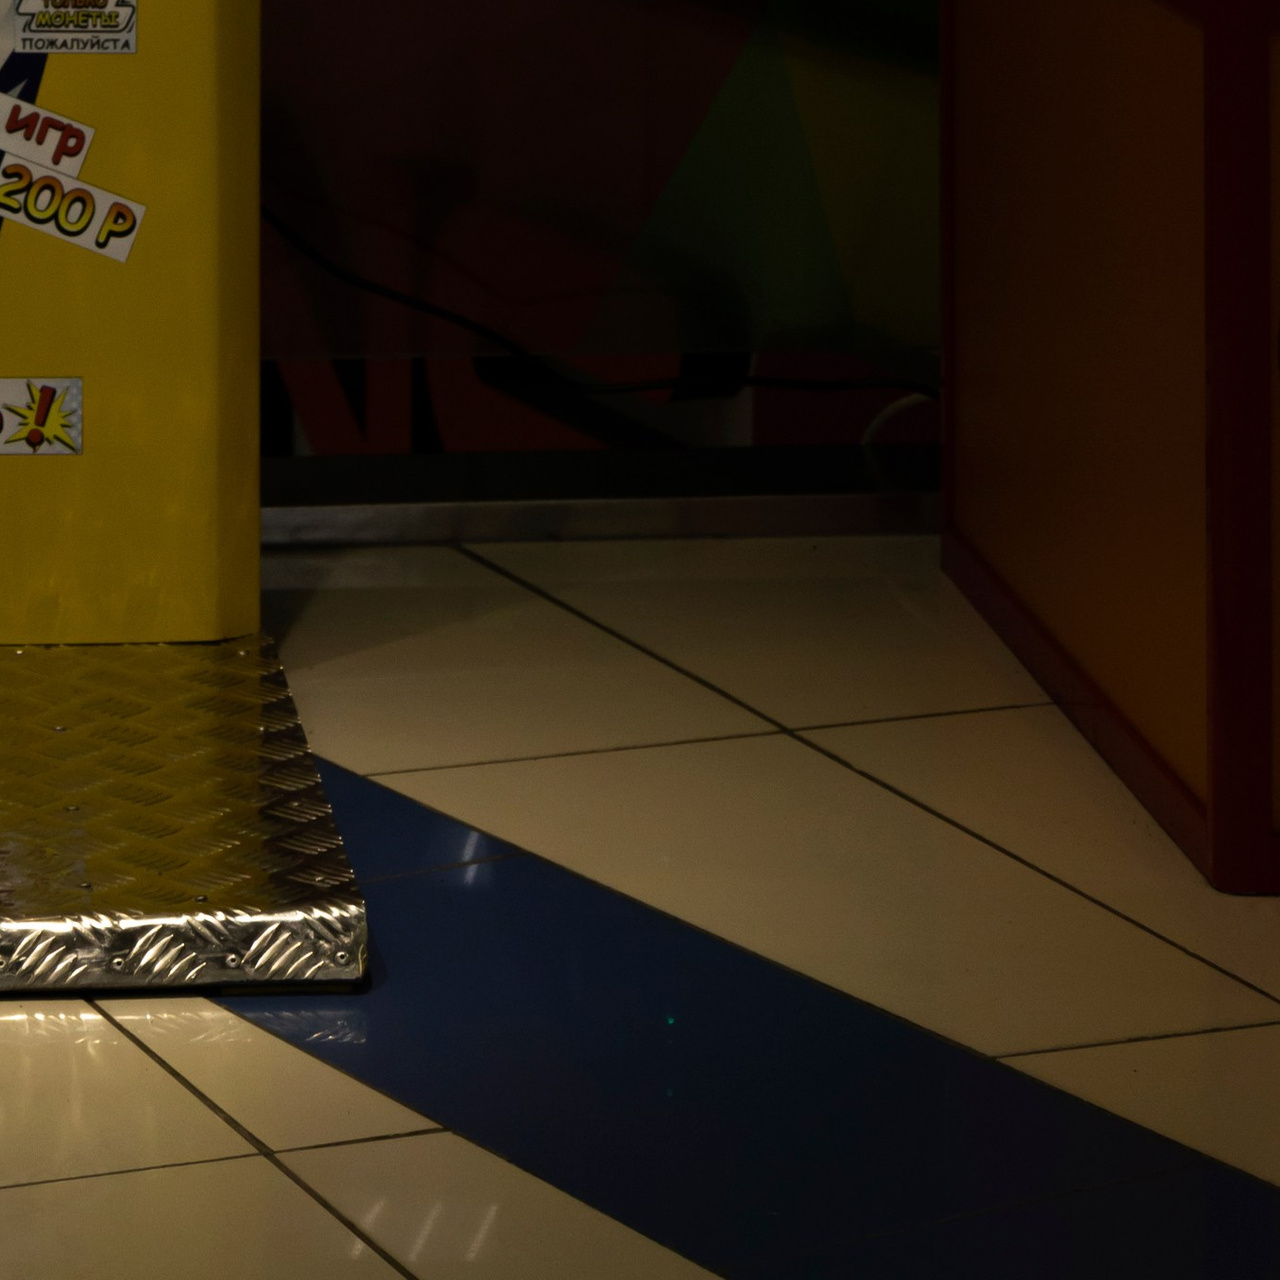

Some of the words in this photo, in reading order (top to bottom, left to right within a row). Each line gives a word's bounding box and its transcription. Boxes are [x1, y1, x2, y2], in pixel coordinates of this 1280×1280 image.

[36, 11, 119, 28] МОНЕТЫ
[22, 36, 131, 50] ПОЖАЛУЙСТА
[6, 104, 86, 165] игр
